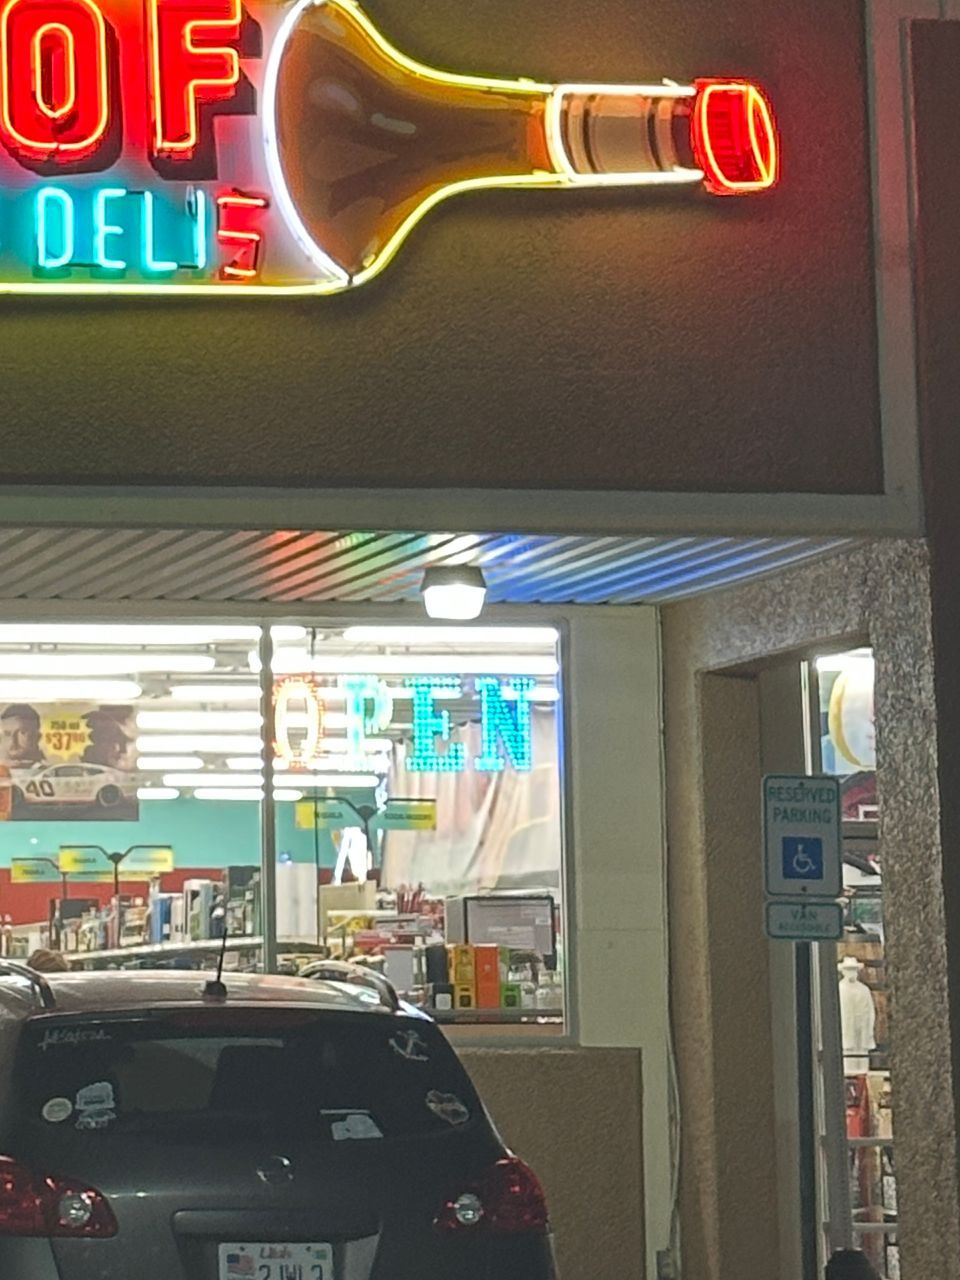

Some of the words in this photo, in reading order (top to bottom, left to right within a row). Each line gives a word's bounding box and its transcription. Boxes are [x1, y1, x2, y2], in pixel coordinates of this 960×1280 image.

[35, 188, 207, 271] DELI
[273, 674, 534, 773] OPEN
[25, 780, 55, 798] 40
[768, 785, 836, 803] RESERVED
[773, 806, 832, 824] PARKING
[792, 909, 818, 920] VAN
